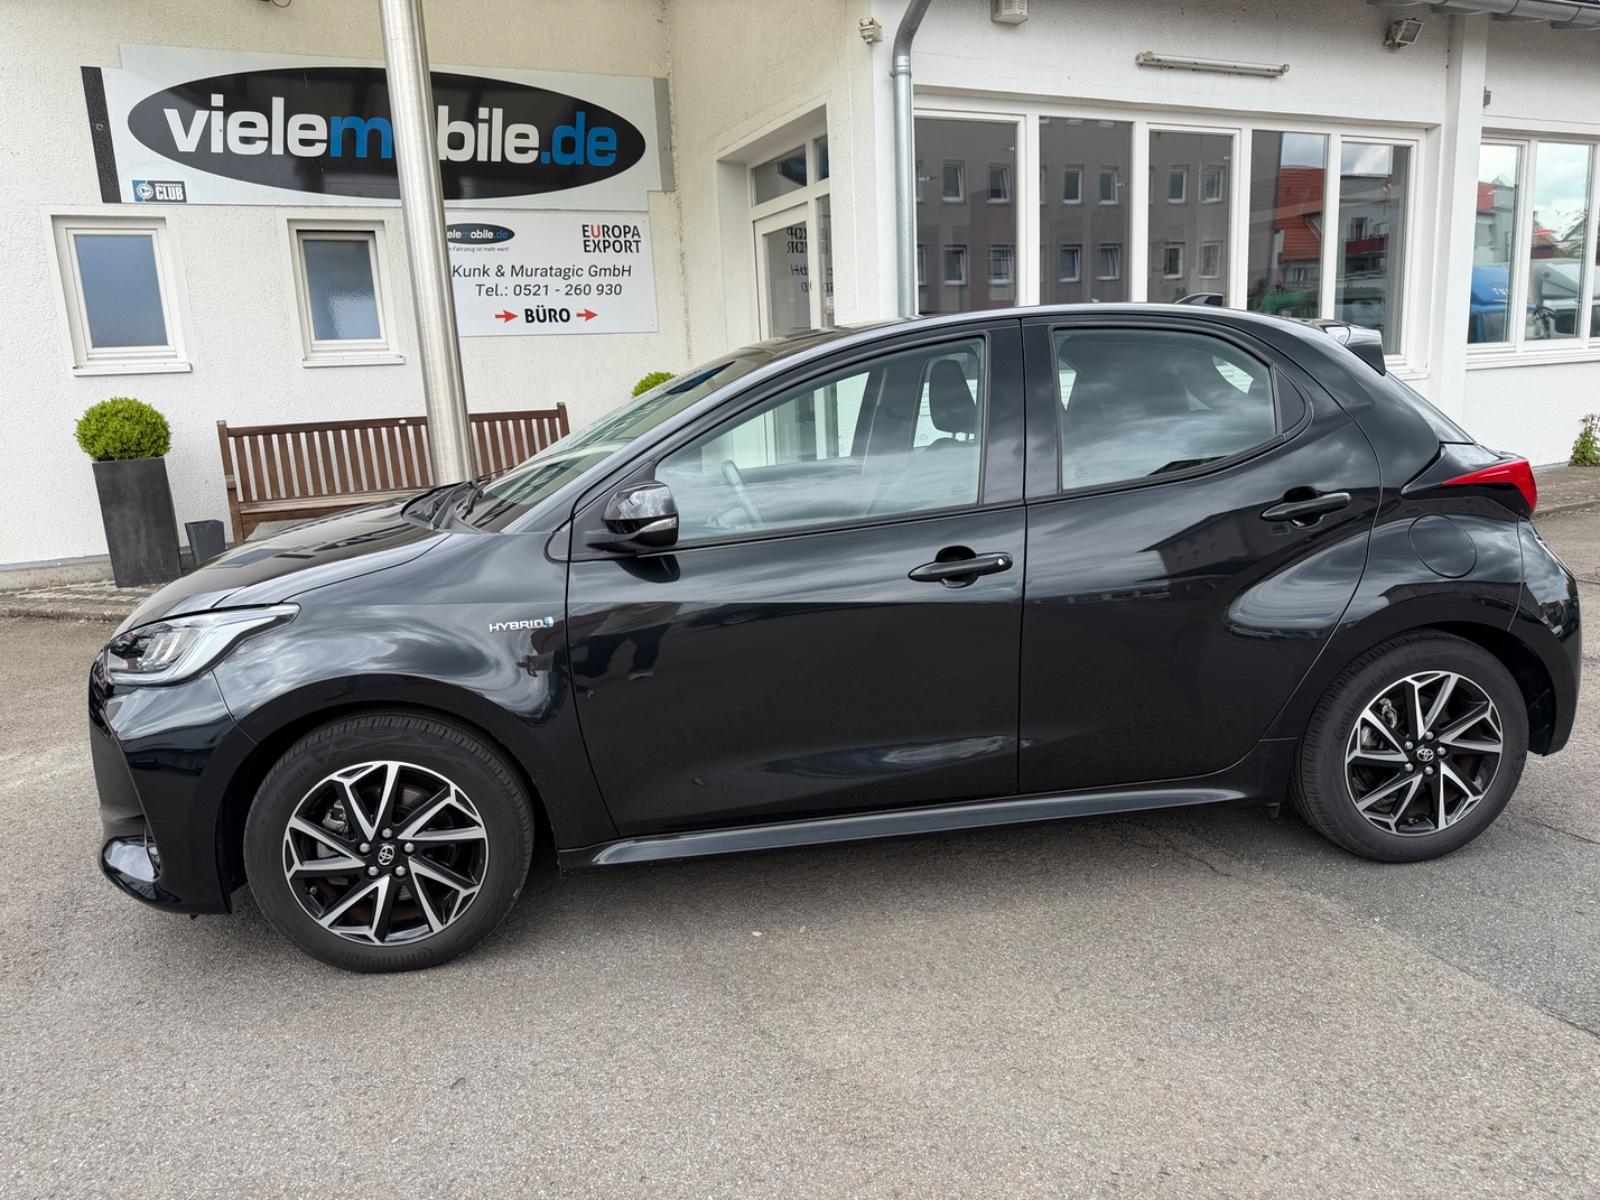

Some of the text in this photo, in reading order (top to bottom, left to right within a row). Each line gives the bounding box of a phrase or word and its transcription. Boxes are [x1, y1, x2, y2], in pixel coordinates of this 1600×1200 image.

[163, 93, 618, 167] vielembile.de
[155, 187, 184, 200] CLUB
[447, 229, 509, 240] elemobile.de
[582, 224, 641, 239] EUROPA
[583, 240, 641, 254] EXPORT
[452, 264, 632, 280] Kunk & Muratagic GmbH
[475, 284, 509, 297] Tel.:
[513, 284, 549, 297] 0521
[565, 284, 591, 296] 260
[596, 283, 623, 296] 930
[524, 305, 571, 323] BÜRO
[488, 619, 544, 633] HYBRID
